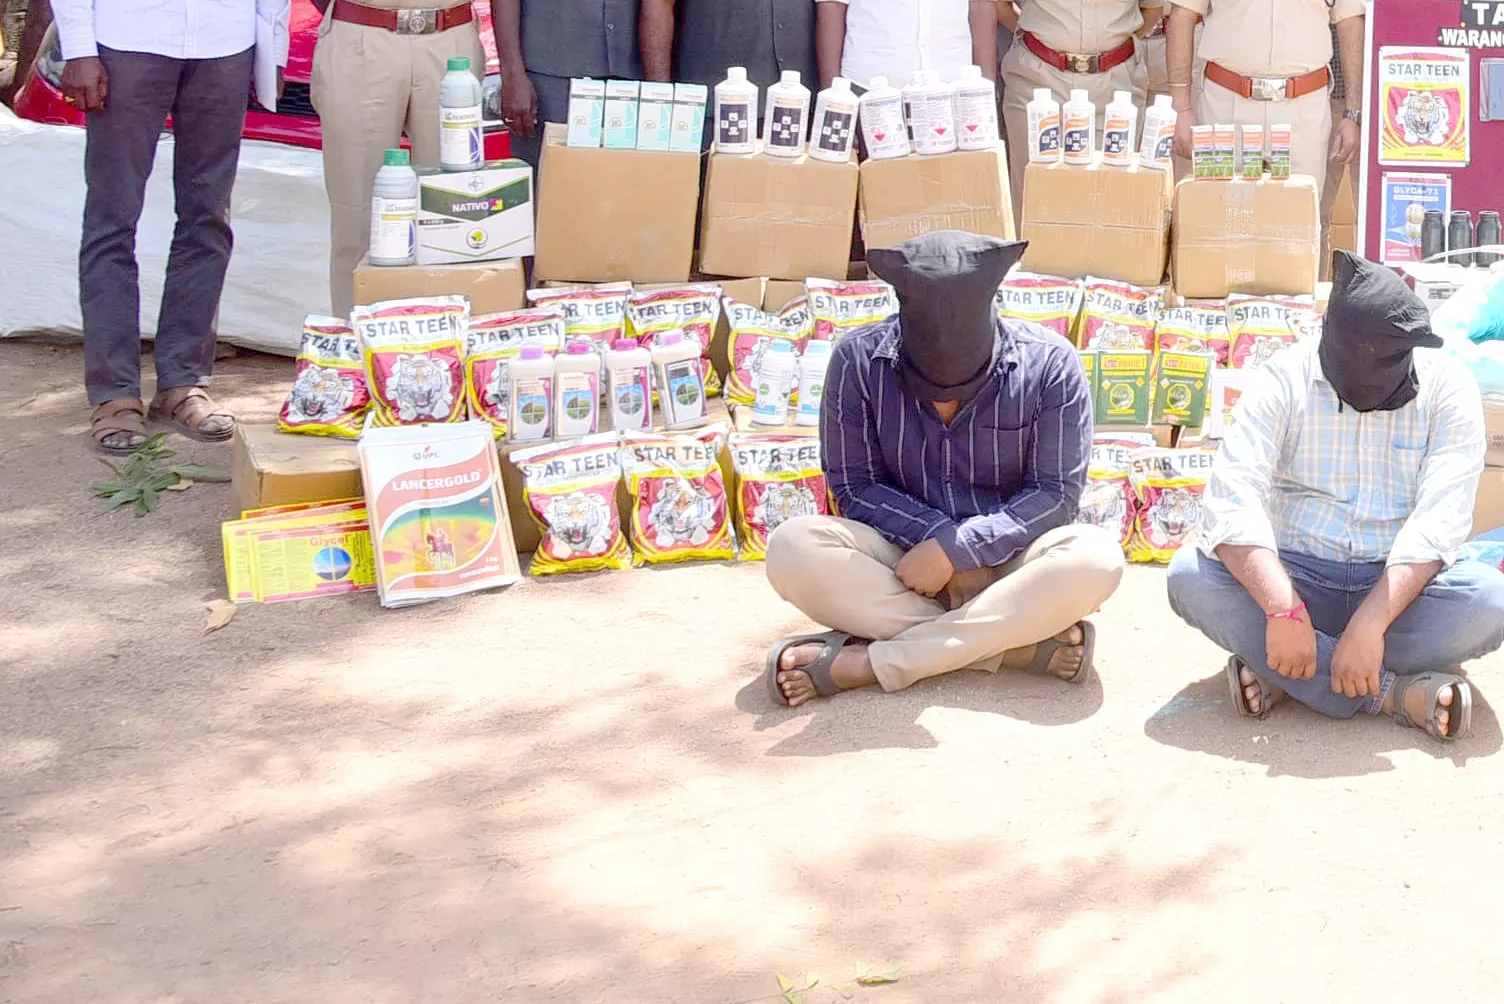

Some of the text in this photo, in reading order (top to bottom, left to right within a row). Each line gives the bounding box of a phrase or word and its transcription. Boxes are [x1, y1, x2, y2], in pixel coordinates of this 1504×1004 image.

[1388, 63, 1460, 77] STAR TEEN
[452, 201, 489, 212] NATIVO
[854, 296, 890, 308] TEEN
[996, 288, 1074, 304] STAR TEEN
[1086, 293, 1122, 311] STAR
[584, 300, 626, 316] TEEN
[674, 300, 712, 316] TEEN
[1159, 309, 1193, 323] STAR
[1235, 306, 1270, 322] STAR
[367, 314, 456, 338] STAR TEEN
[780, 308, 809, 327] EEN
[302, 332, 338, 353] STAR
[467, 323, 560, 347] STAR TEEN
[635, 445, 717, 463] STAR TEE
[738, 446, 819, 465] STAR TEE
[523, 451, 619, 480] STAR TEEN
[1133, 456, 1173, 473] STAR
[391, 471, 481, 491] LANCERGOLD
[310, 534, 349, 547] Glycel
